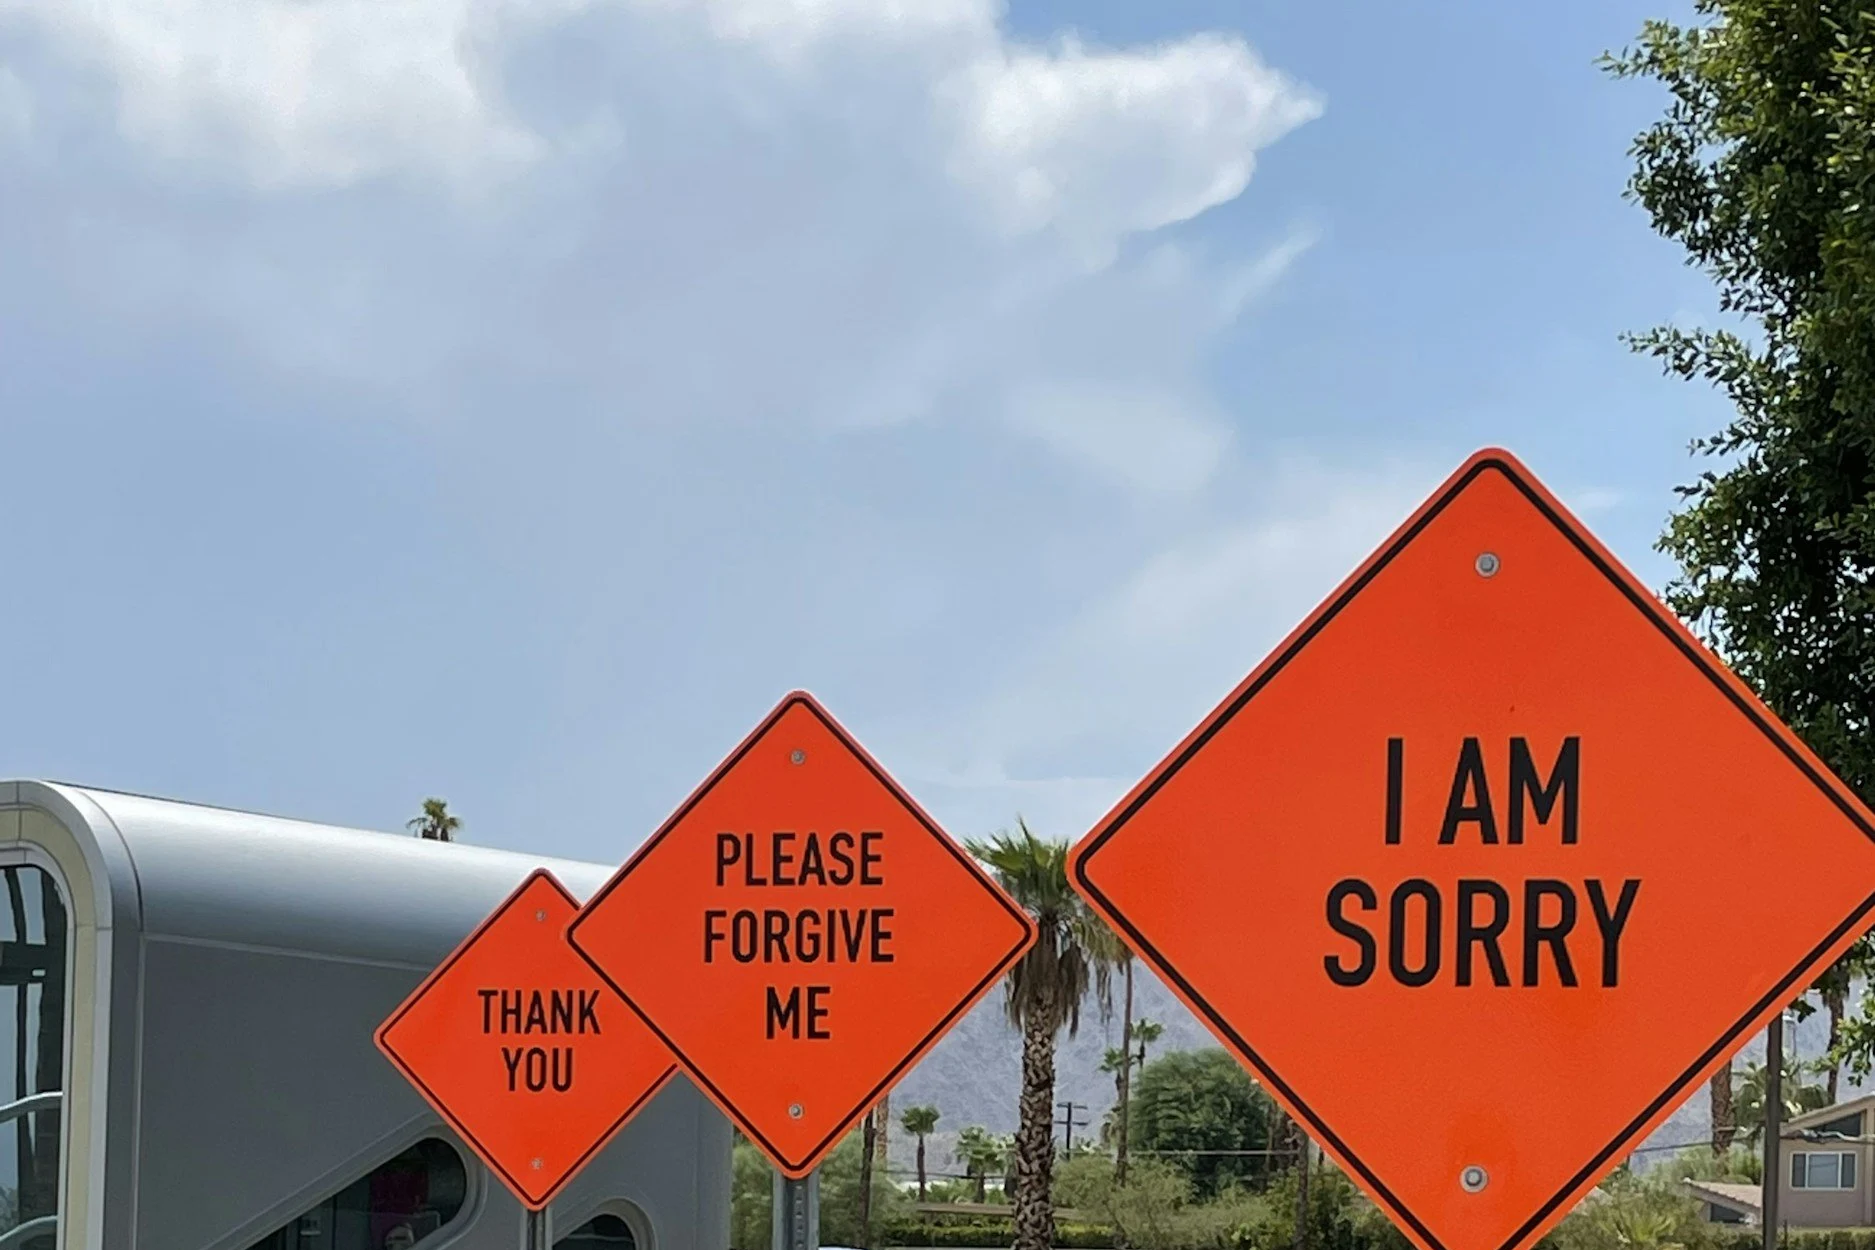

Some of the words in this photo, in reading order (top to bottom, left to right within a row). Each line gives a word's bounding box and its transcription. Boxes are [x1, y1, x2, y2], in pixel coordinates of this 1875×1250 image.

[1386, 738, 1404, 844] I
[1438, 737, 1580, 844] AM
[717, 832, 883, 886] PLEASE
[705, 909, 894, 963] FORGIVE
[1324, 879, 1641, 987] SORRY
[478, 990, 602, 1034] THANK
[767, 987, 831, 1039] ME
[502, 1048, 573, 1092] YOU
